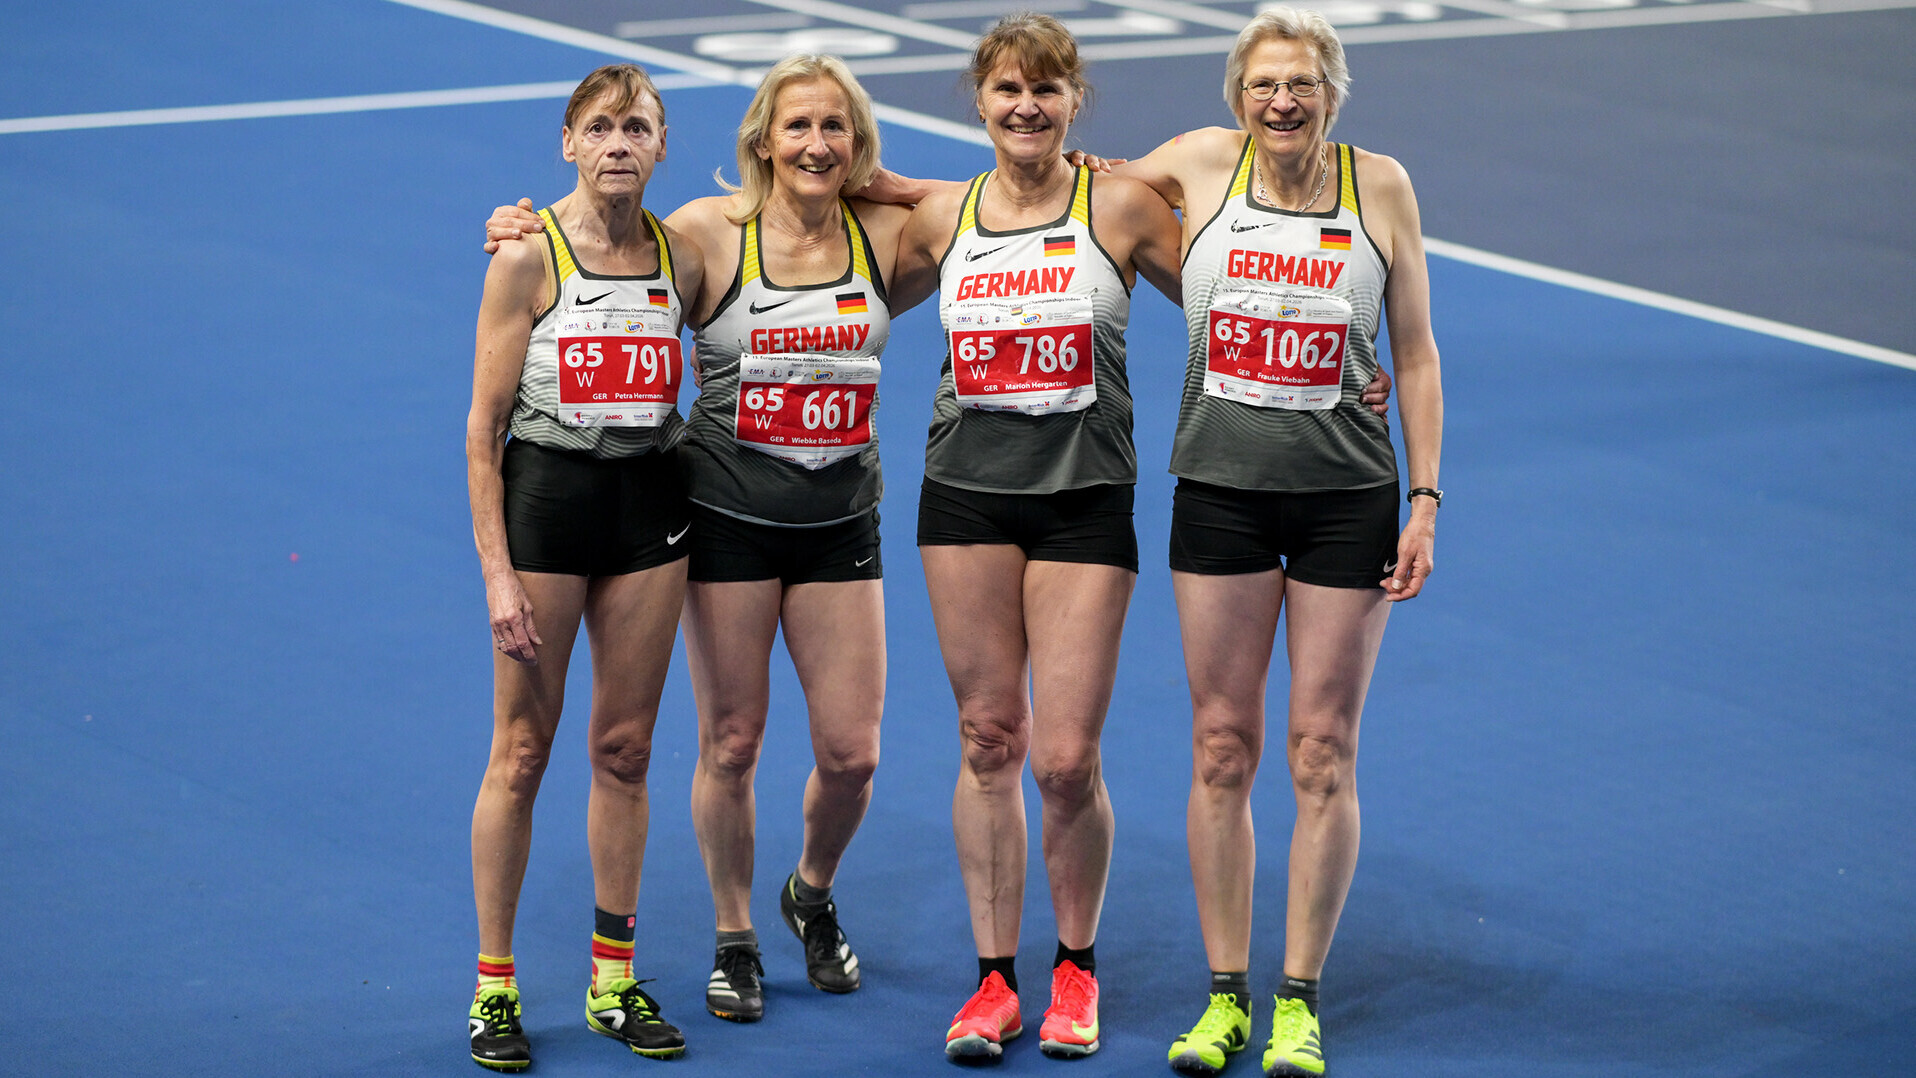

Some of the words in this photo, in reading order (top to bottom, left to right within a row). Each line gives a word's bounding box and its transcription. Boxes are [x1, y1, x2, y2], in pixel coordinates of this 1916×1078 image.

[1227, 248, 1345, 290] GERMANY
[956, 266, 1076, 302] GERMANY
[750, 323, 871, 355] GERMANY
[1214, 318, 1250, 345] 65
[1260, 327, 1340, 370] 1062
[958, 336, 996, 362] 65
[1015, 332, 1078, 375] 786
[1223, 344, 1241, 362] W
[564, 342, 604, 368] 65
[621, 344, 671, 385] 791
[969, 363, 988, 380] W
[576, 371, 595, 388] W
[1237, 368, 1251, 377] GER
[1257, 372, 1281, 382] Frauke
[1281, 375, 1311, 384] Viebahn
[983, 384, 999, 392] GER
[1005, 383, 1031, 391] Marion
[1031, 381, 1068, 390] Hergarten
[592, 392, 608, 400] GER
[745, 386, 784, 412] 65
[802, 390, 858, 430] 661
[754, 413, 773, 430] W
[769, 435, 785, 443] GER
[791, 436, 818, 445] Wiebke
